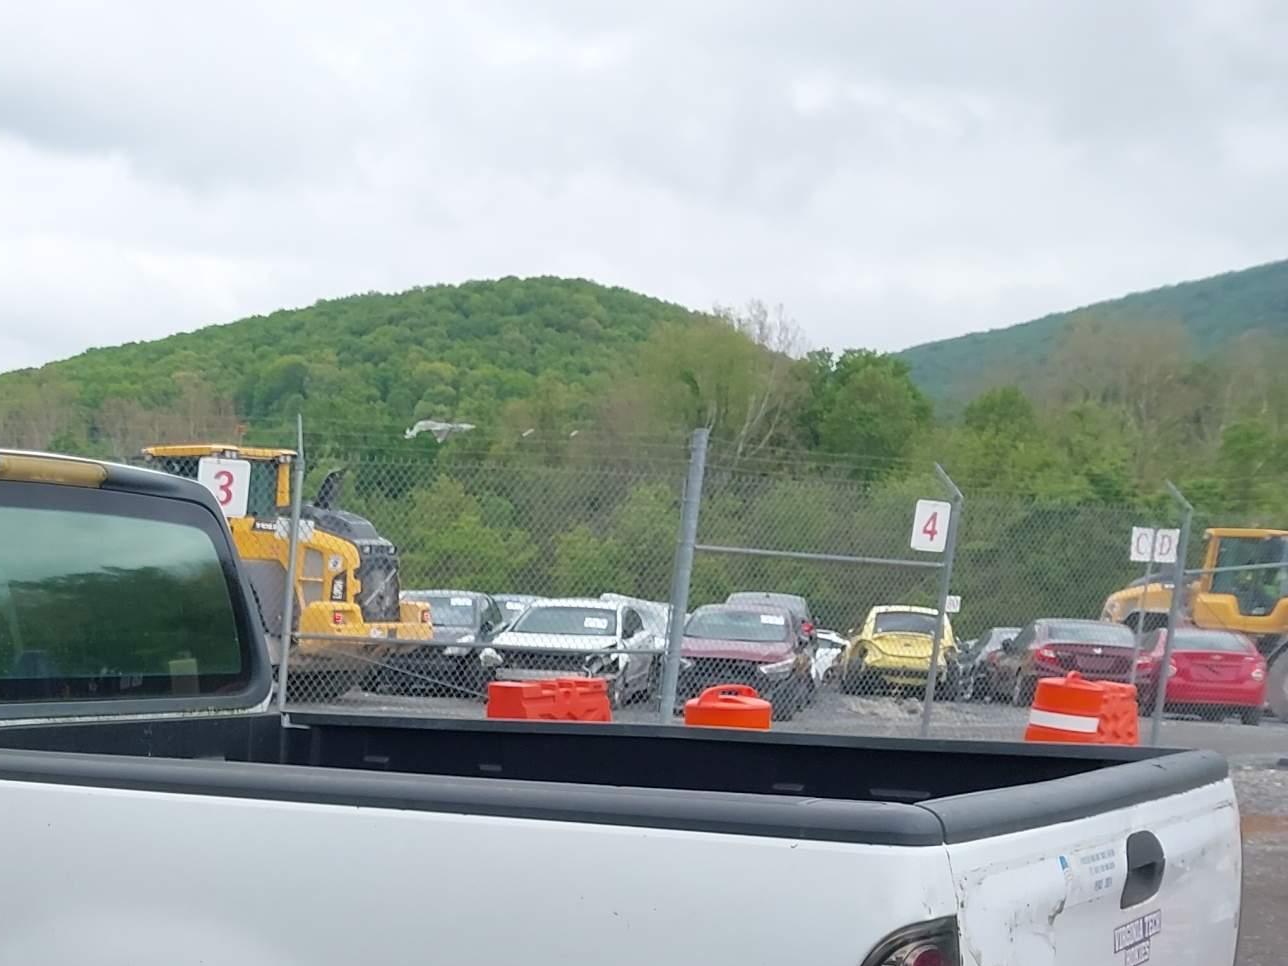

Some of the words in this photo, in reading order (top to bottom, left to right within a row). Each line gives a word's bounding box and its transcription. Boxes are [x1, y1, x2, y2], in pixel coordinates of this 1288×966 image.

[214, 470, 234, 506] 3
[923, 511, 938, 542] 4
[1137, 532, 1148, 556] C
[1159, 534, 1172, 555] D
